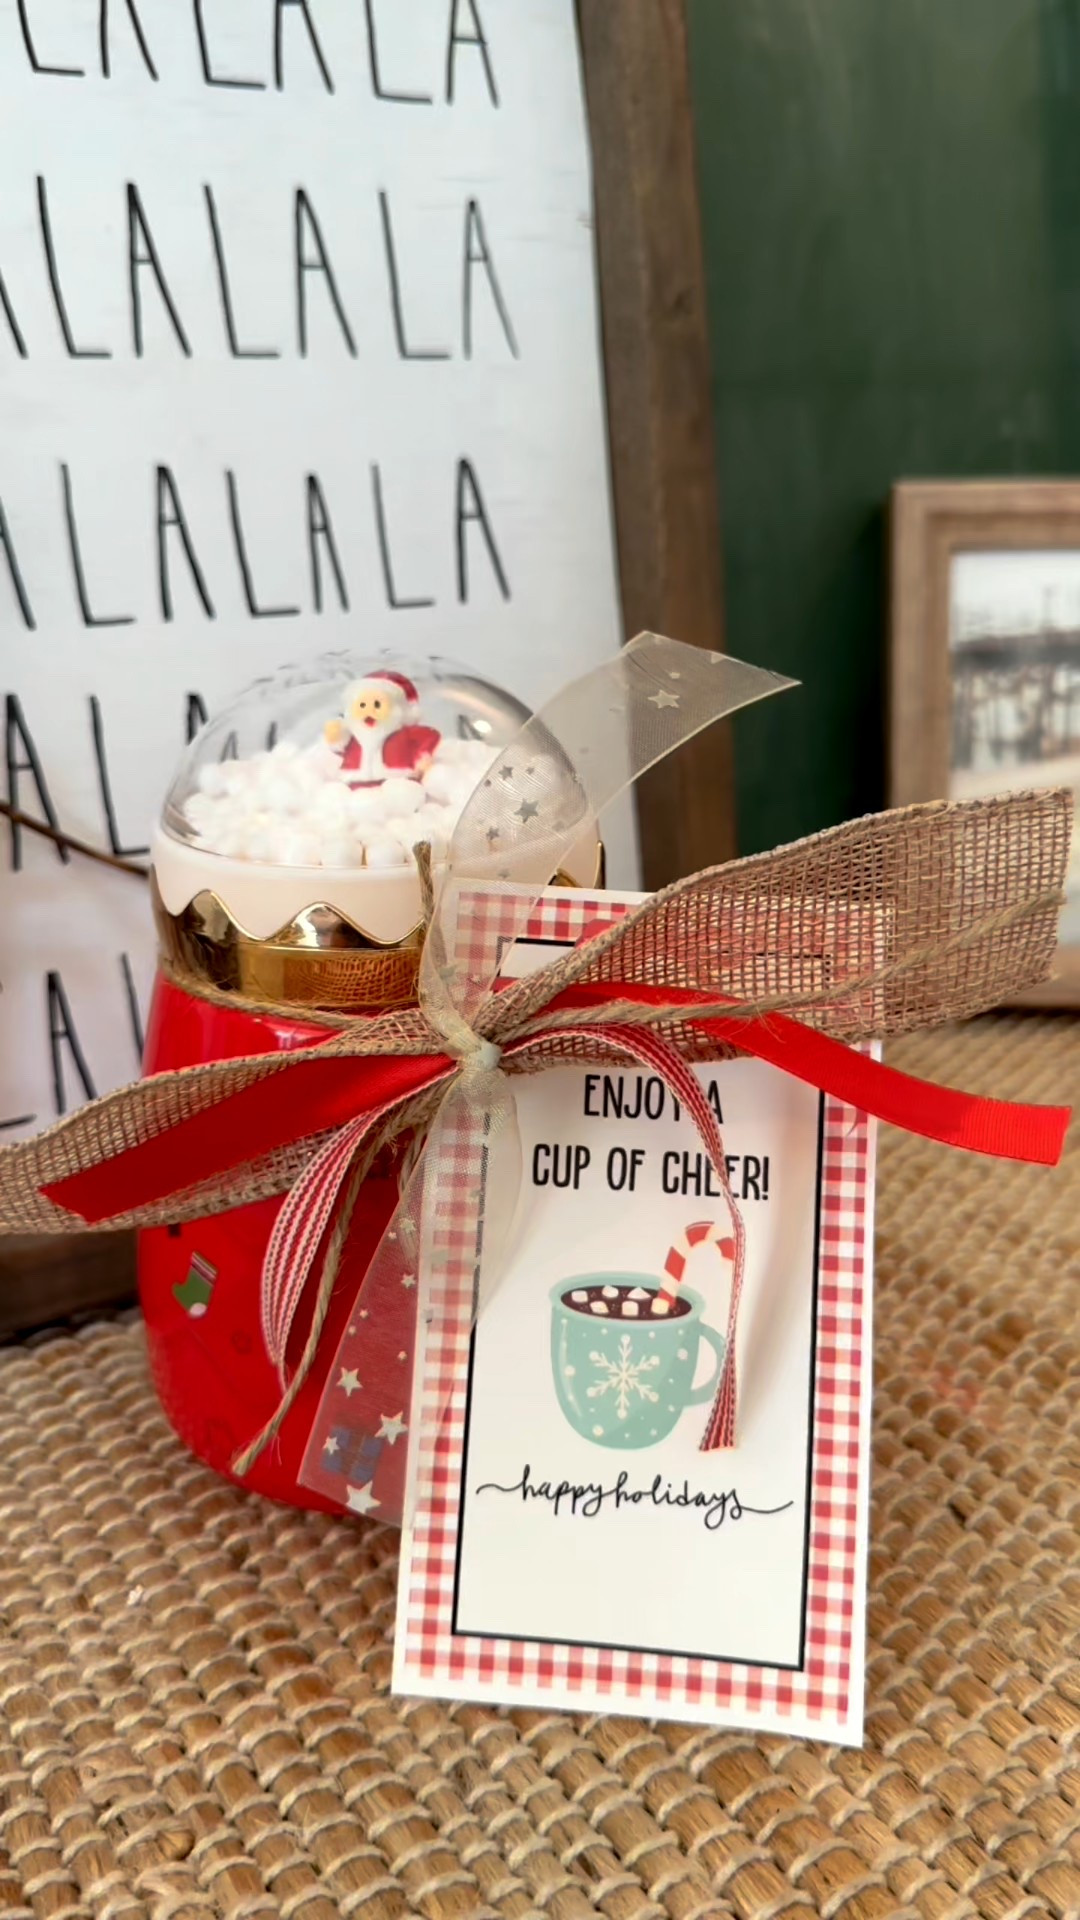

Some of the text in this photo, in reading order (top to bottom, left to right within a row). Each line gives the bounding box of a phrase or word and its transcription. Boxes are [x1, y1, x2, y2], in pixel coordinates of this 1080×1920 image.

[706, 1079, 724, 1124] A
[532, 1143, 770, 1201] CUP OF CHEER!
[477, 1464, 794, 1530] happy holidays
